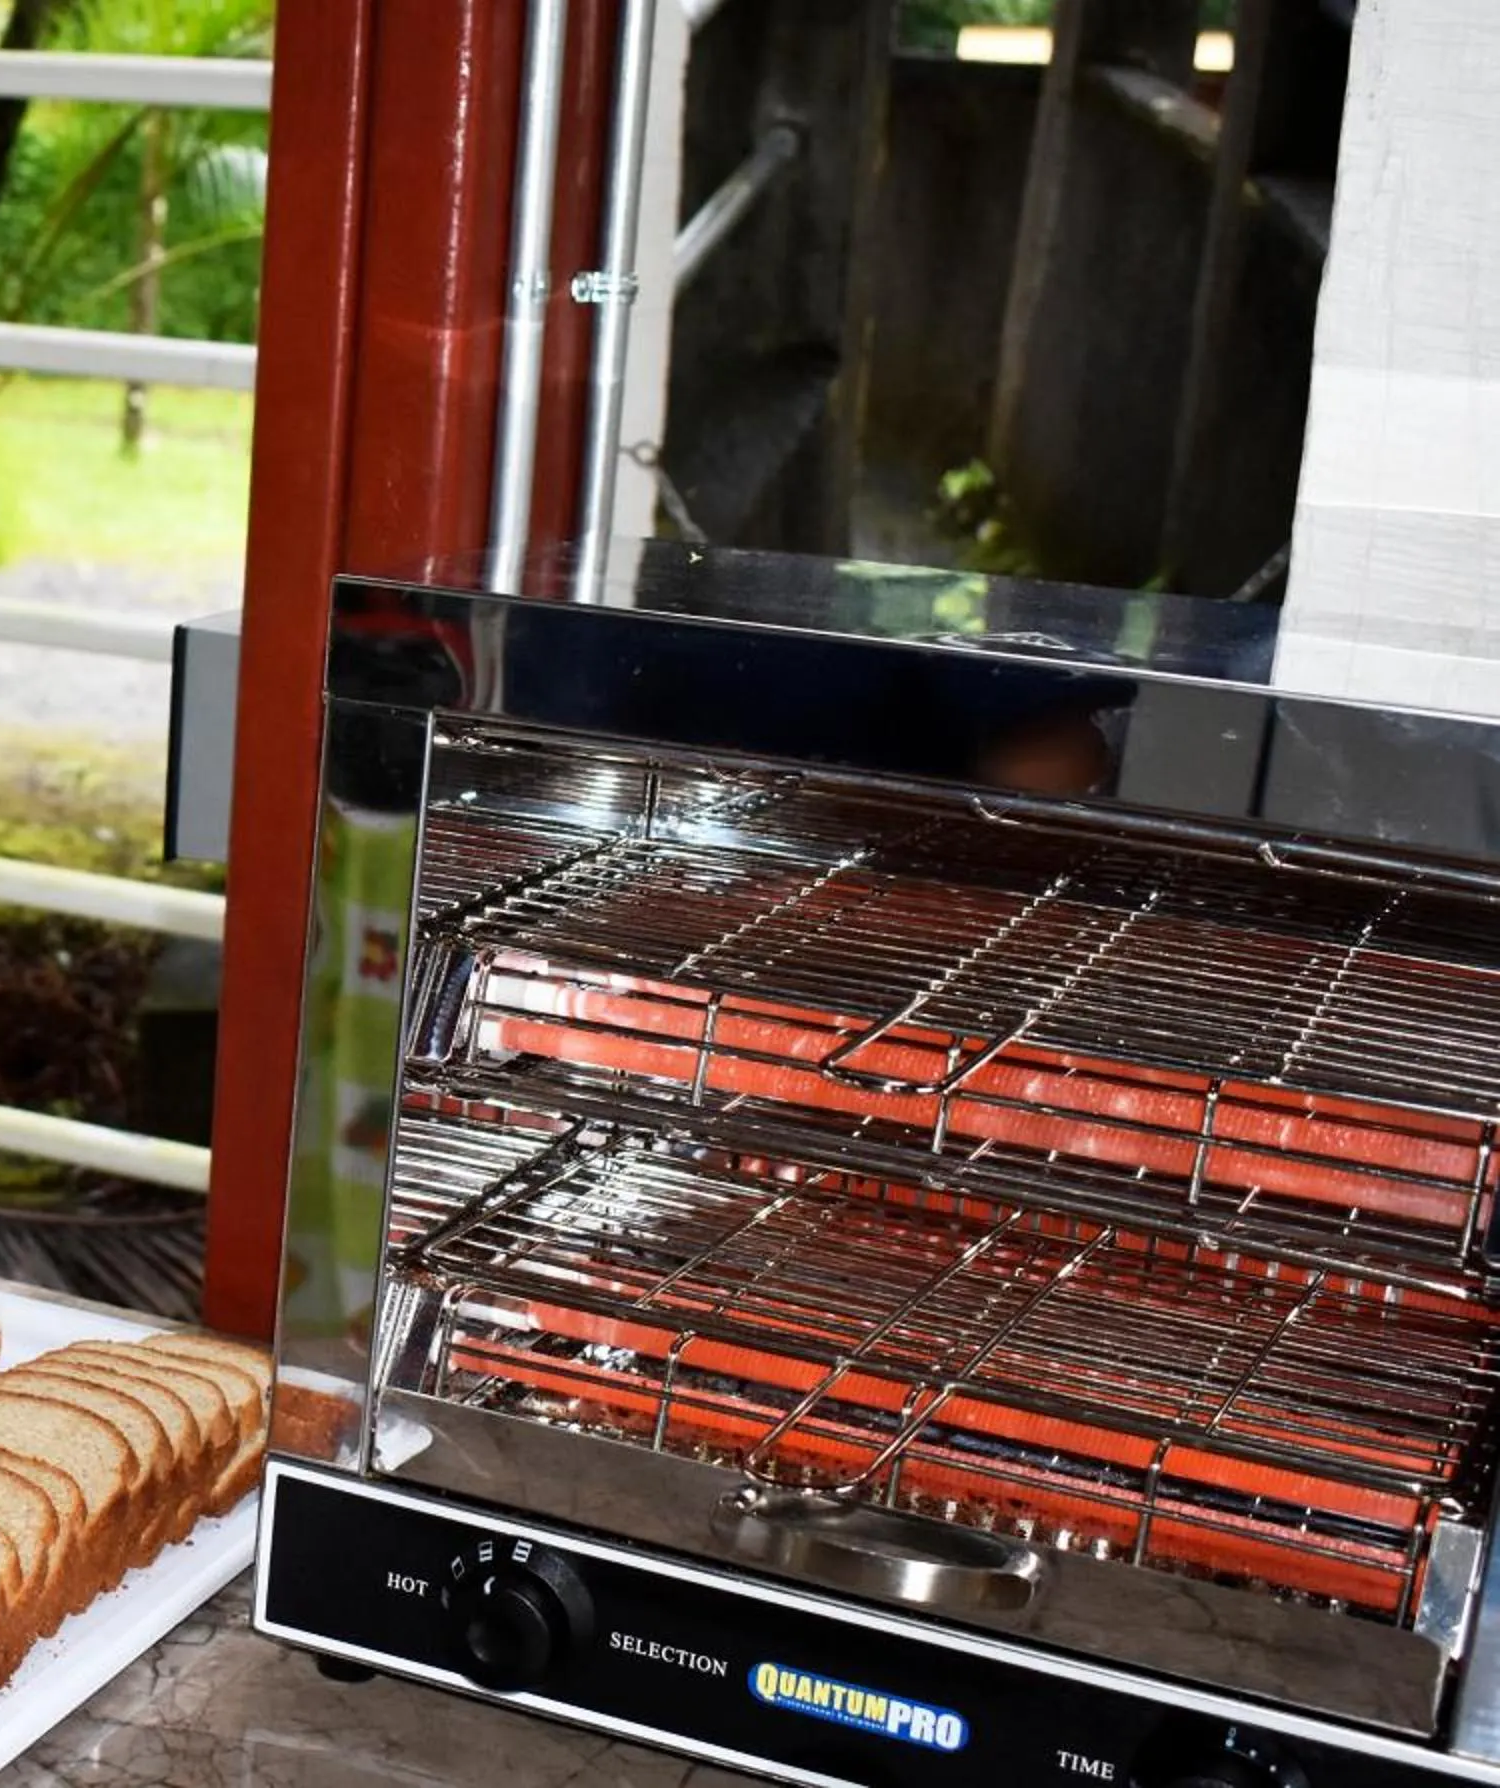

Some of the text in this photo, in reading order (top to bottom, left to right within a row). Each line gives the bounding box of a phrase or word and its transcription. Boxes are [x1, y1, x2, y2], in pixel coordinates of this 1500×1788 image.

[386, 1572, 429, 1597] HOT
[609, 1631, 729, 1678] SELECTION
[1056, 1749, 1116, 1781] TIME
